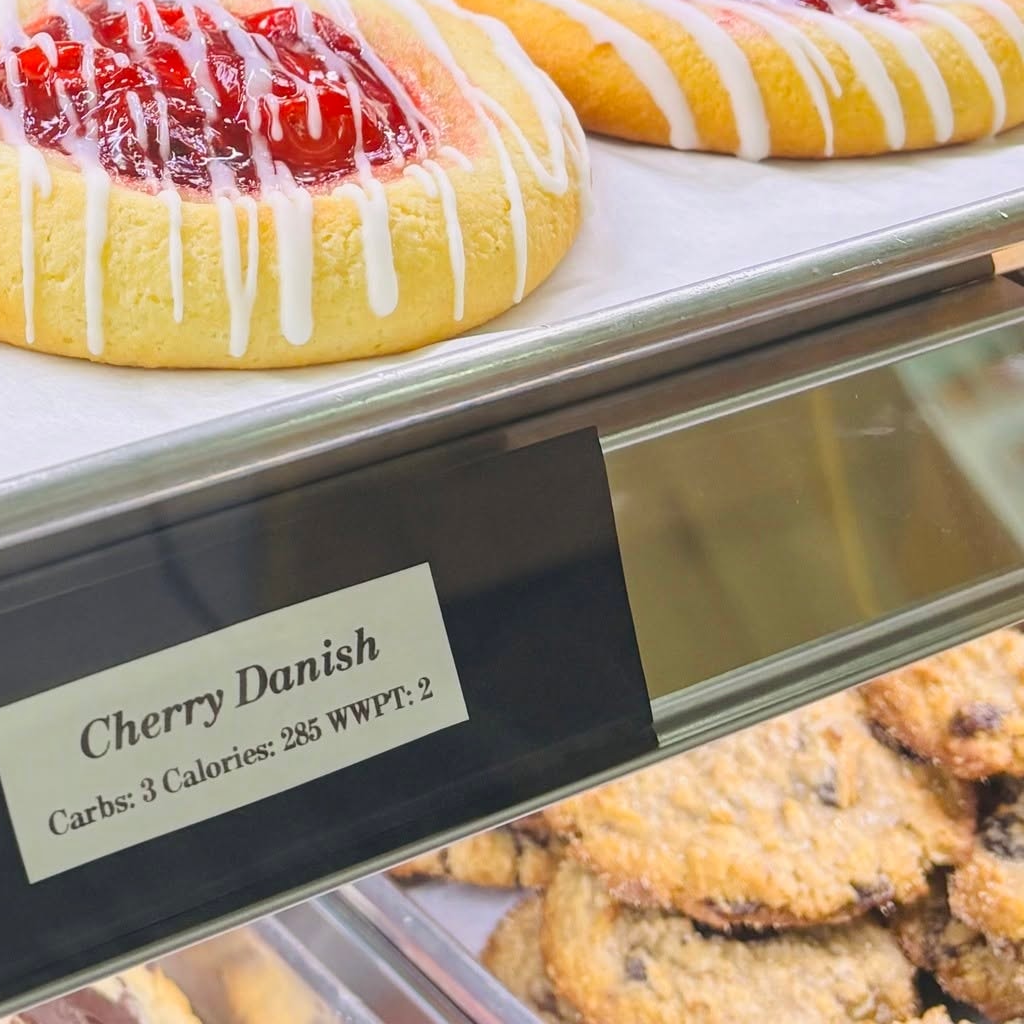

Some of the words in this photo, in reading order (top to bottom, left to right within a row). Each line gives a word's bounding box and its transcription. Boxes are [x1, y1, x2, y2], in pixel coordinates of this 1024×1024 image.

[48, 792, 136, 836] Carbs:
[140, 779, 157, 803] 3
[162, 740, 276, 794] Calories:
[281, 718, 322, 751] 285
[326, 687, 414, 733] WWPT:
[419, 677, 434, 701] 2
[79, 689, 224, 759] Cherry
[234, 627, 380, 708] Danish
